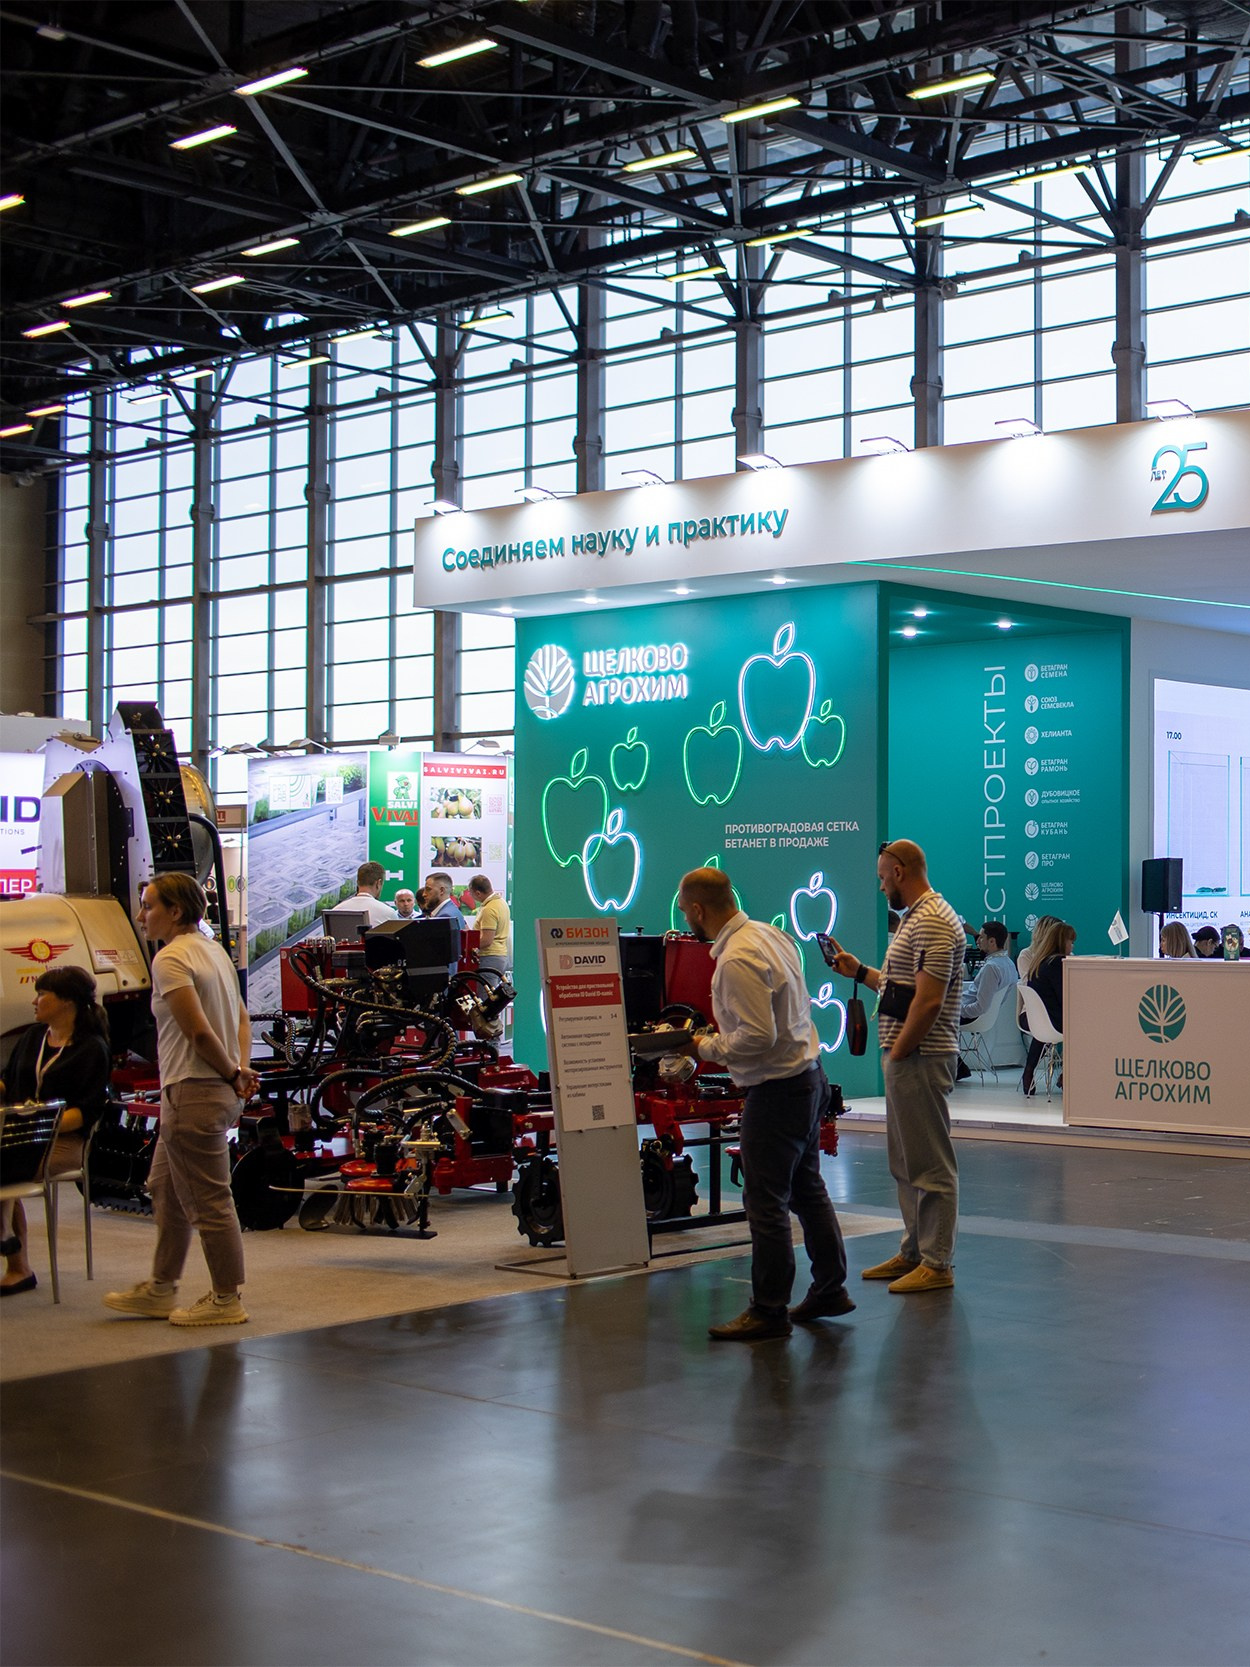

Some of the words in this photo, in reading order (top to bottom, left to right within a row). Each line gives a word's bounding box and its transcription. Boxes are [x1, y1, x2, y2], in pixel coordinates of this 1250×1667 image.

[1152, 442, 1209, 512] 25
[442, 537, 564, 572] Соединяем
[571, 525, 639, 557] науку
[646, 524, 660, 546] и
[667, 508, 789, 548] практику
[583, 643, 688, 677] ЩЕЛКОВО
[1041, 664, 1068, 672] БЕТАГРАН
[582, 673, 688, 706] АГРОХИМ
[1041, 730, 1072, 738] ХЕЛИАНТА
[1166, 731, 1182, 740] 17.00
[424, 766, 505, 776] SALVIVIVAI.RU
[387, 801, 417, 809] SALVI
[725, 822, 824, 834] ПРОТИВОГРАДОВАЯ
[826, 821, 859, 832] СЕТКА
[725, 838, 768, 849] БЕТАНЕТ
[770, 838, 777, 848] В
[779, 837, 829, 849] ПРОДАЖЕ
[566, 927, 609, 939] БИЗОН
[574, 955, 606, 965] DAVID
[1115, 1057, 1211, 1081] ЩЕЛКОВО
[1115, 1081, 1211, 1104] АГРОХИМ
